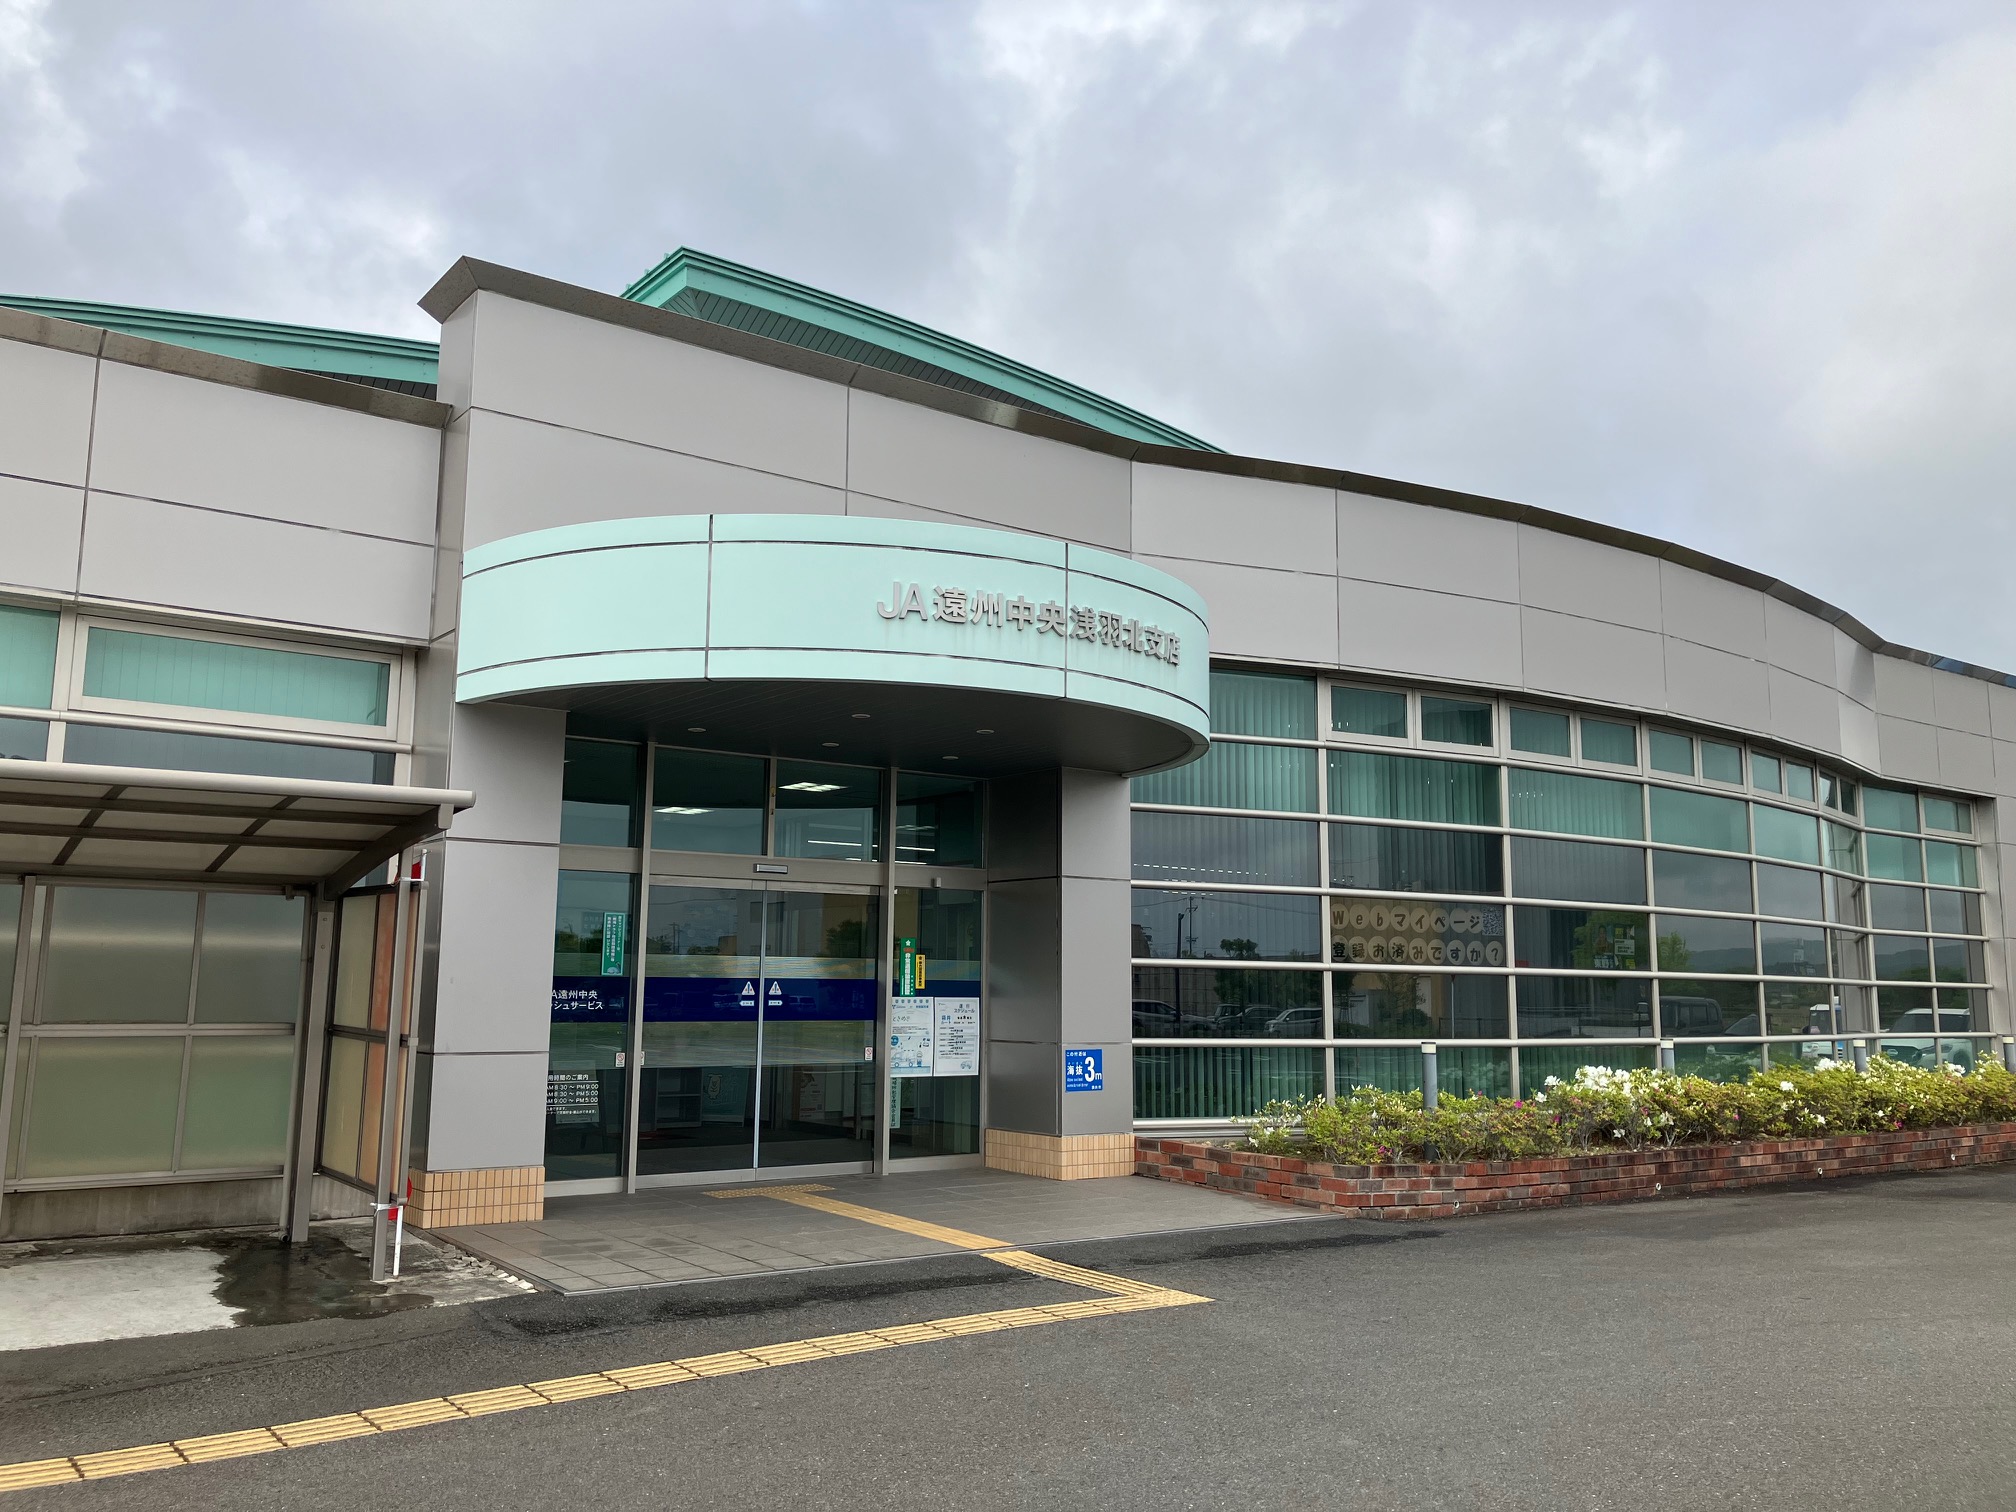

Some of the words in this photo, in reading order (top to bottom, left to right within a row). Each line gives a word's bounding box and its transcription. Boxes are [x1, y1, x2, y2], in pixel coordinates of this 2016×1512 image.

[877, 581, 1181, 666] JA遠州中央浅羽北支店
[1333, 910, 1480, 930] Webマイページ
[551, 1001, 603, 1010] シュサービス
